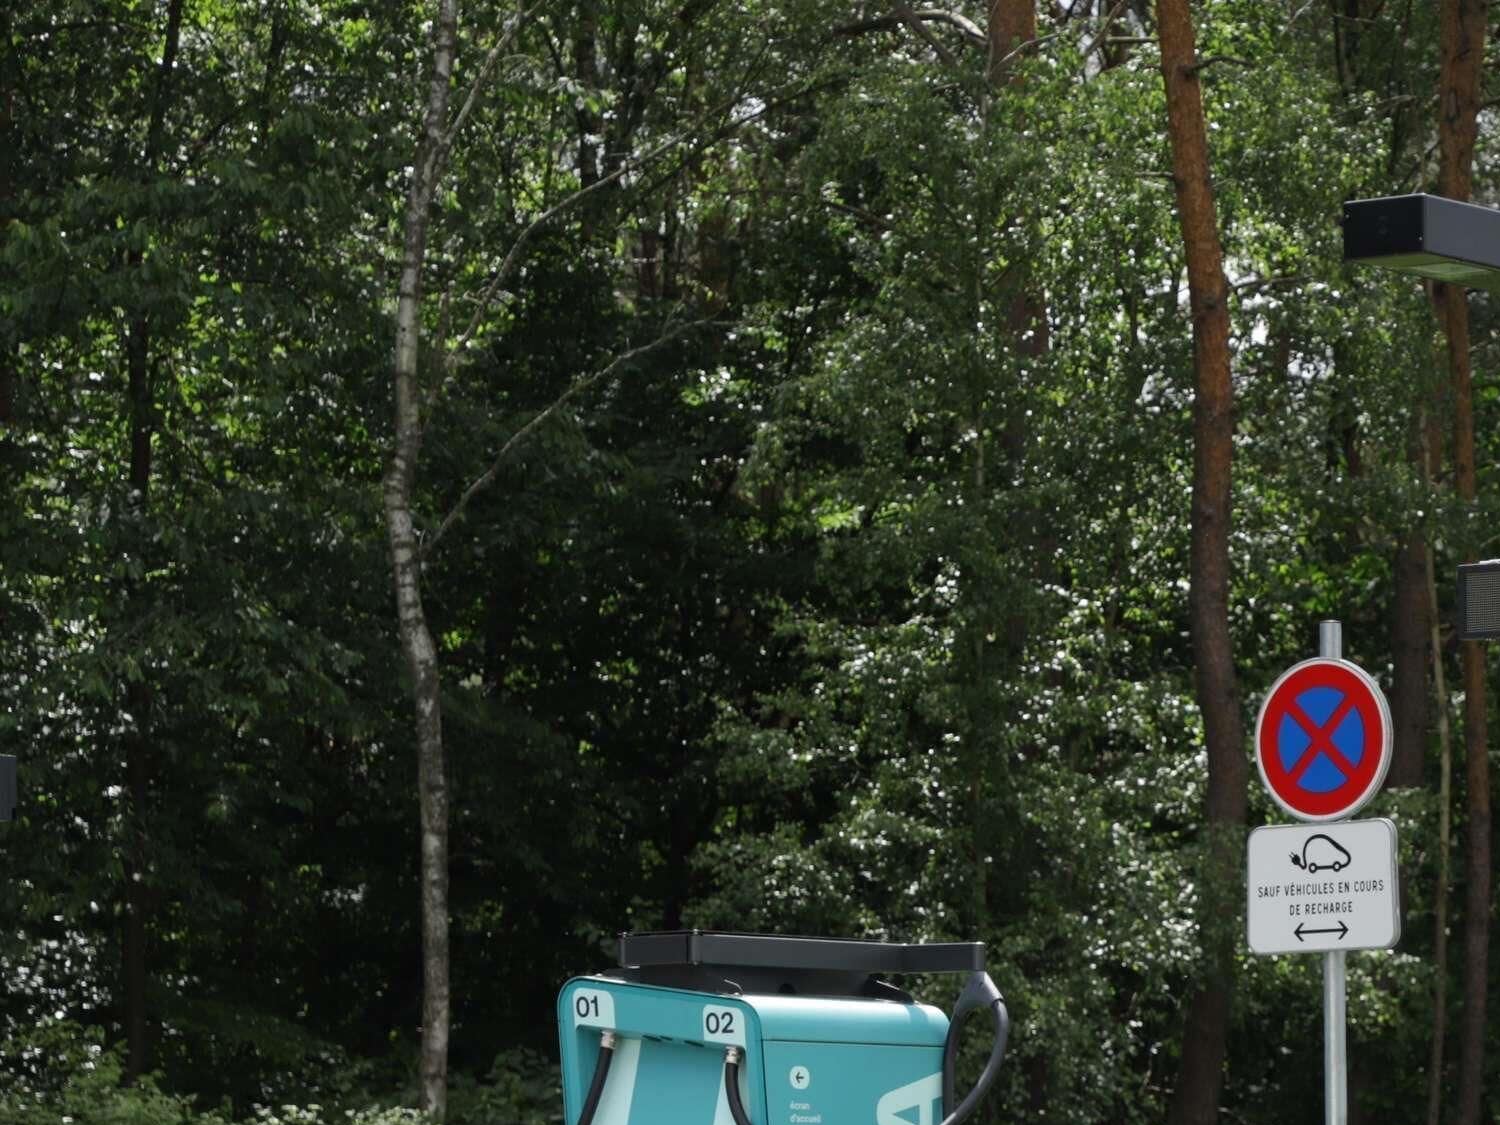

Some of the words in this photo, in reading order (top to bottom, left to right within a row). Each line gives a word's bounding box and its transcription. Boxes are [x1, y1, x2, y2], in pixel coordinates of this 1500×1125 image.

[1258, 887, 1281, 898] SAUF
[1285, 882, 1334, 897] VÉHICULES
[1338, 882, 1350, 893] EN
[1354, 880, 1384, 892] COURS
[1290, 905, 1301, 916] DE
[1304, 901, 1353, 915] RECHARGE
[576, 995, 599, 1018] 01
[705, 1012, 735, 1035] 02
